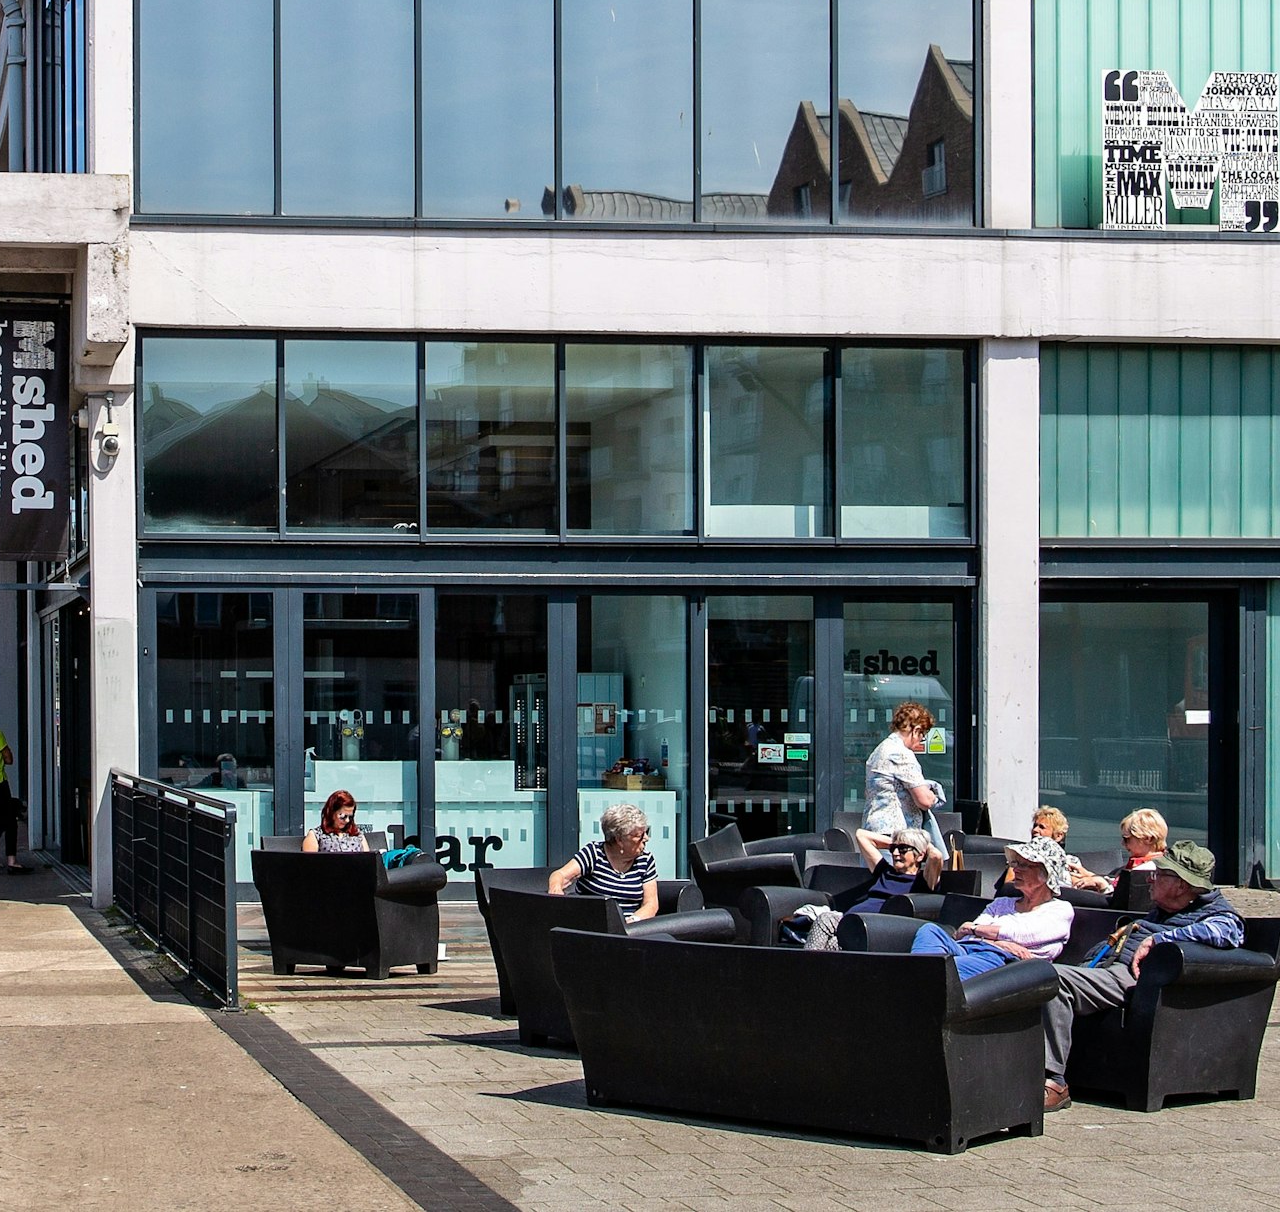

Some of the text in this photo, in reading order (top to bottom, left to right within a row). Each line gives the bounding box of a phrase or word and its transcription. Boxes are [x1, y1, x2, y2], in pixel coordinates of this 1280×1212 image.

[1214, 73, 1277, 84] EVERYBODY
[1206, 87, 1277, 96] JOHNNY RAY
[1169, 128, 1191, 136] WENT
[1194, 128, 1204, 136] TO
[1206, 128, 1220, 136] SEE
[1104, 145, 1161, 163] TIME
[1117, 171, 1162, 196] MAX
[1168, 164, 1215, 189] BRISTOL
[1221, 171, 1279, 180] THE LOCAL
[1106, 196, 1163, 224] MILLER
[11, 375, 55, 514] shed
[863, 649, 940, 675] shed
